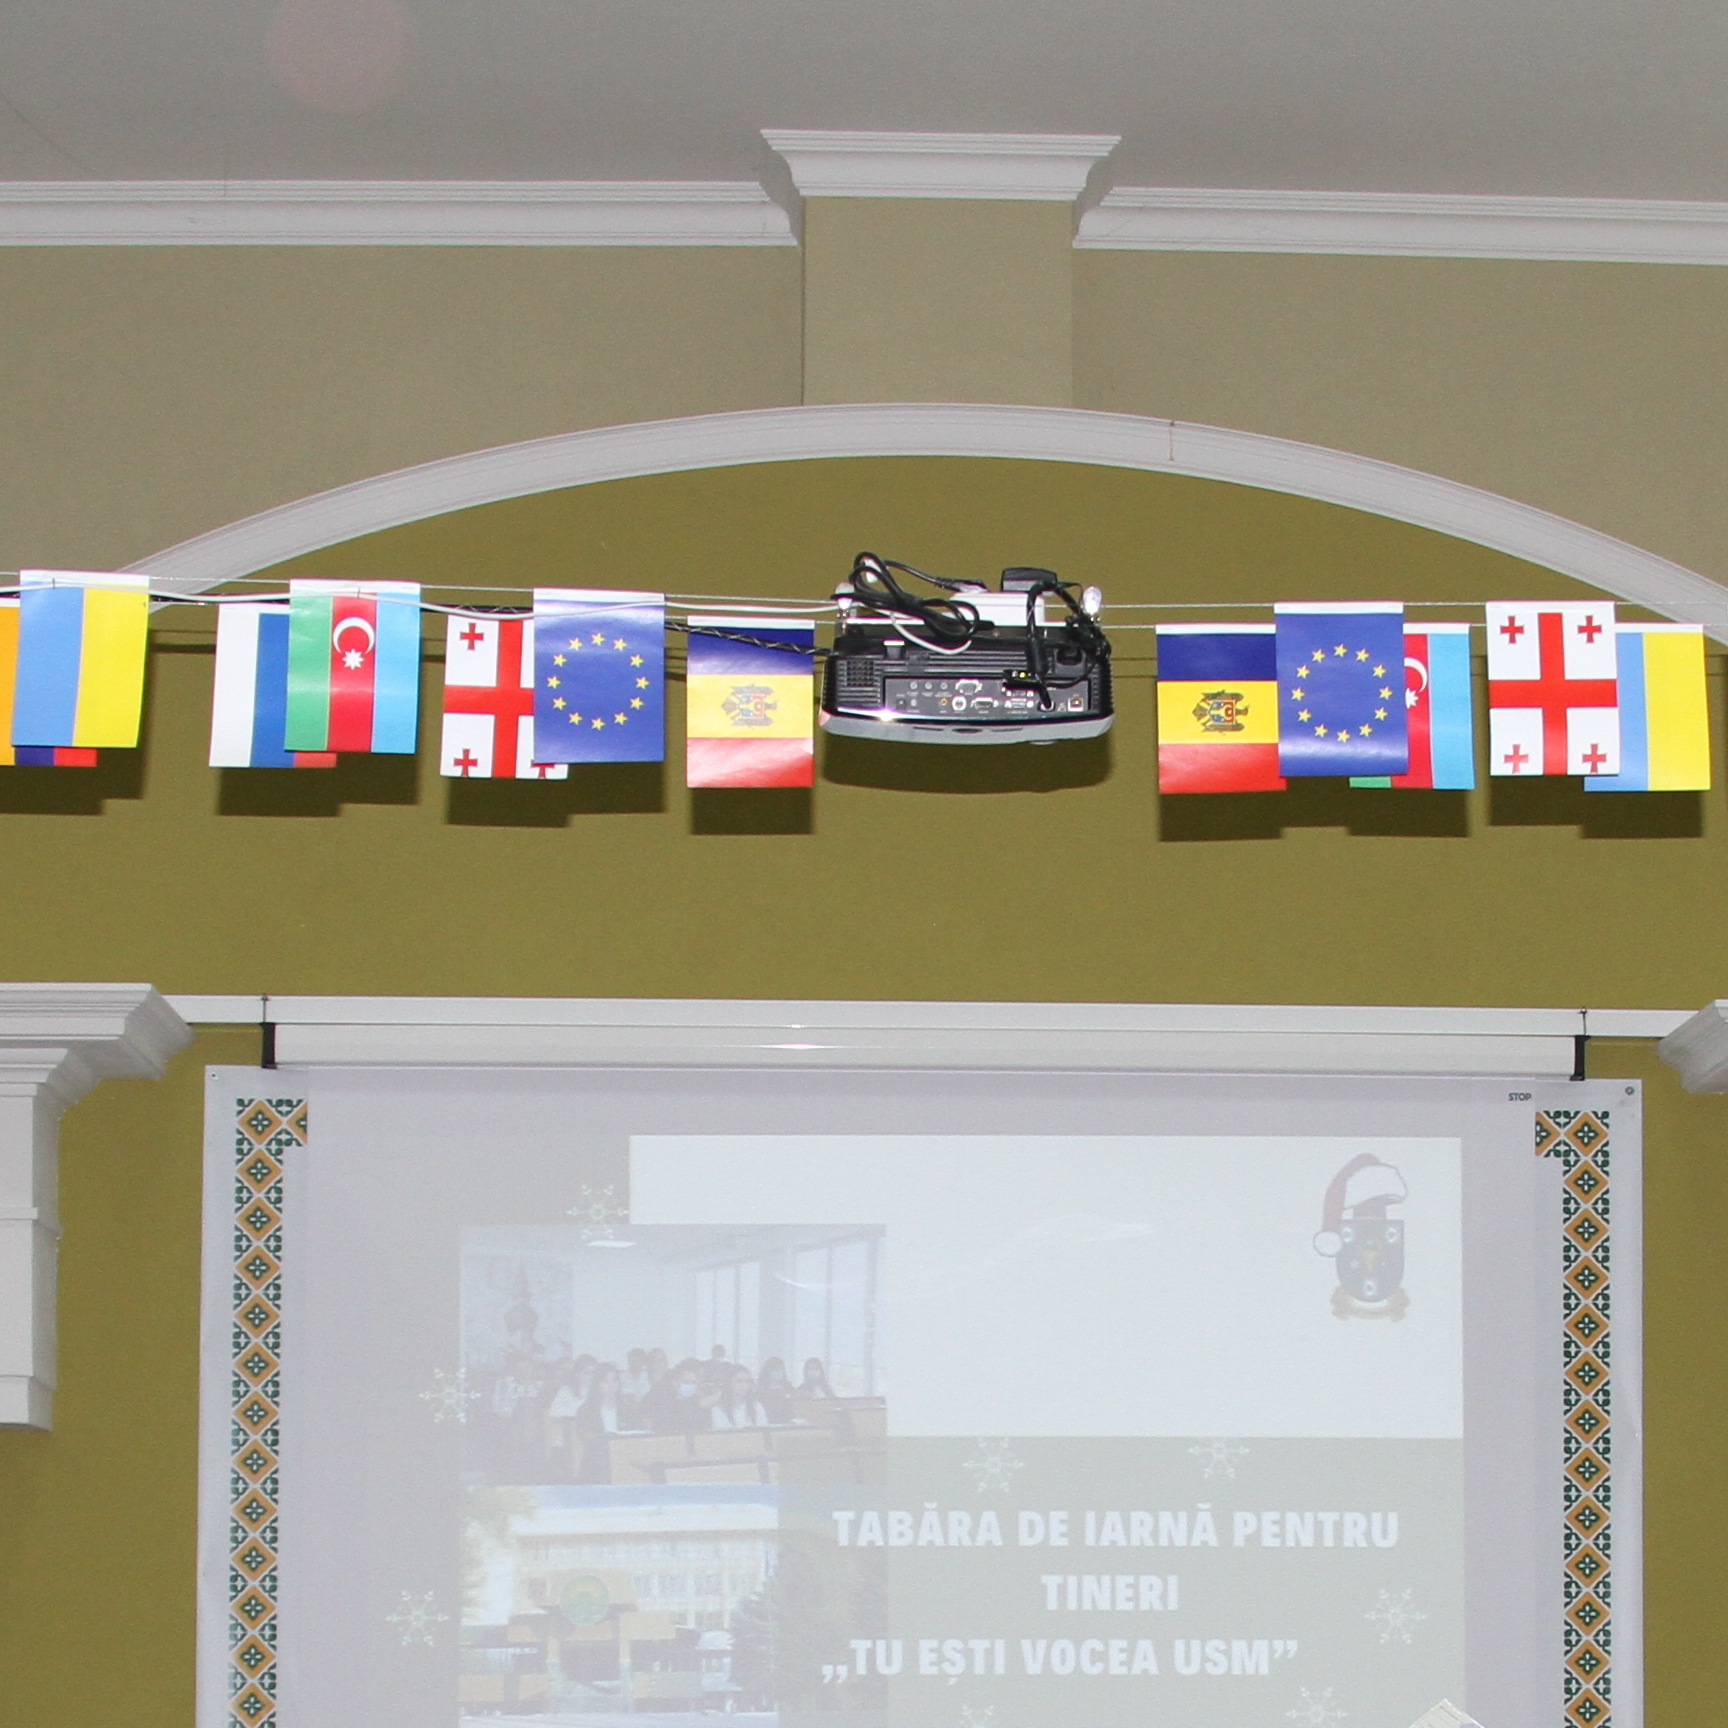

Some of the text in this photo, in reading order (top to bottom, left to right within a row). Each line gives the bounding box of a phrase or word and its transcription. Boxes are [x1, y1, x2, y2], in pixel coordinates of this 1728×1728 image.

[1508, 1092, 1532, 1101] STOP
[832, 1502, 1400, 1549] TABĂRA DE IARNĂ PENTRU
[1041, 1574, 1179, 1612] TINERI
[1021, 1639, 1160, 1676] VOCEA
